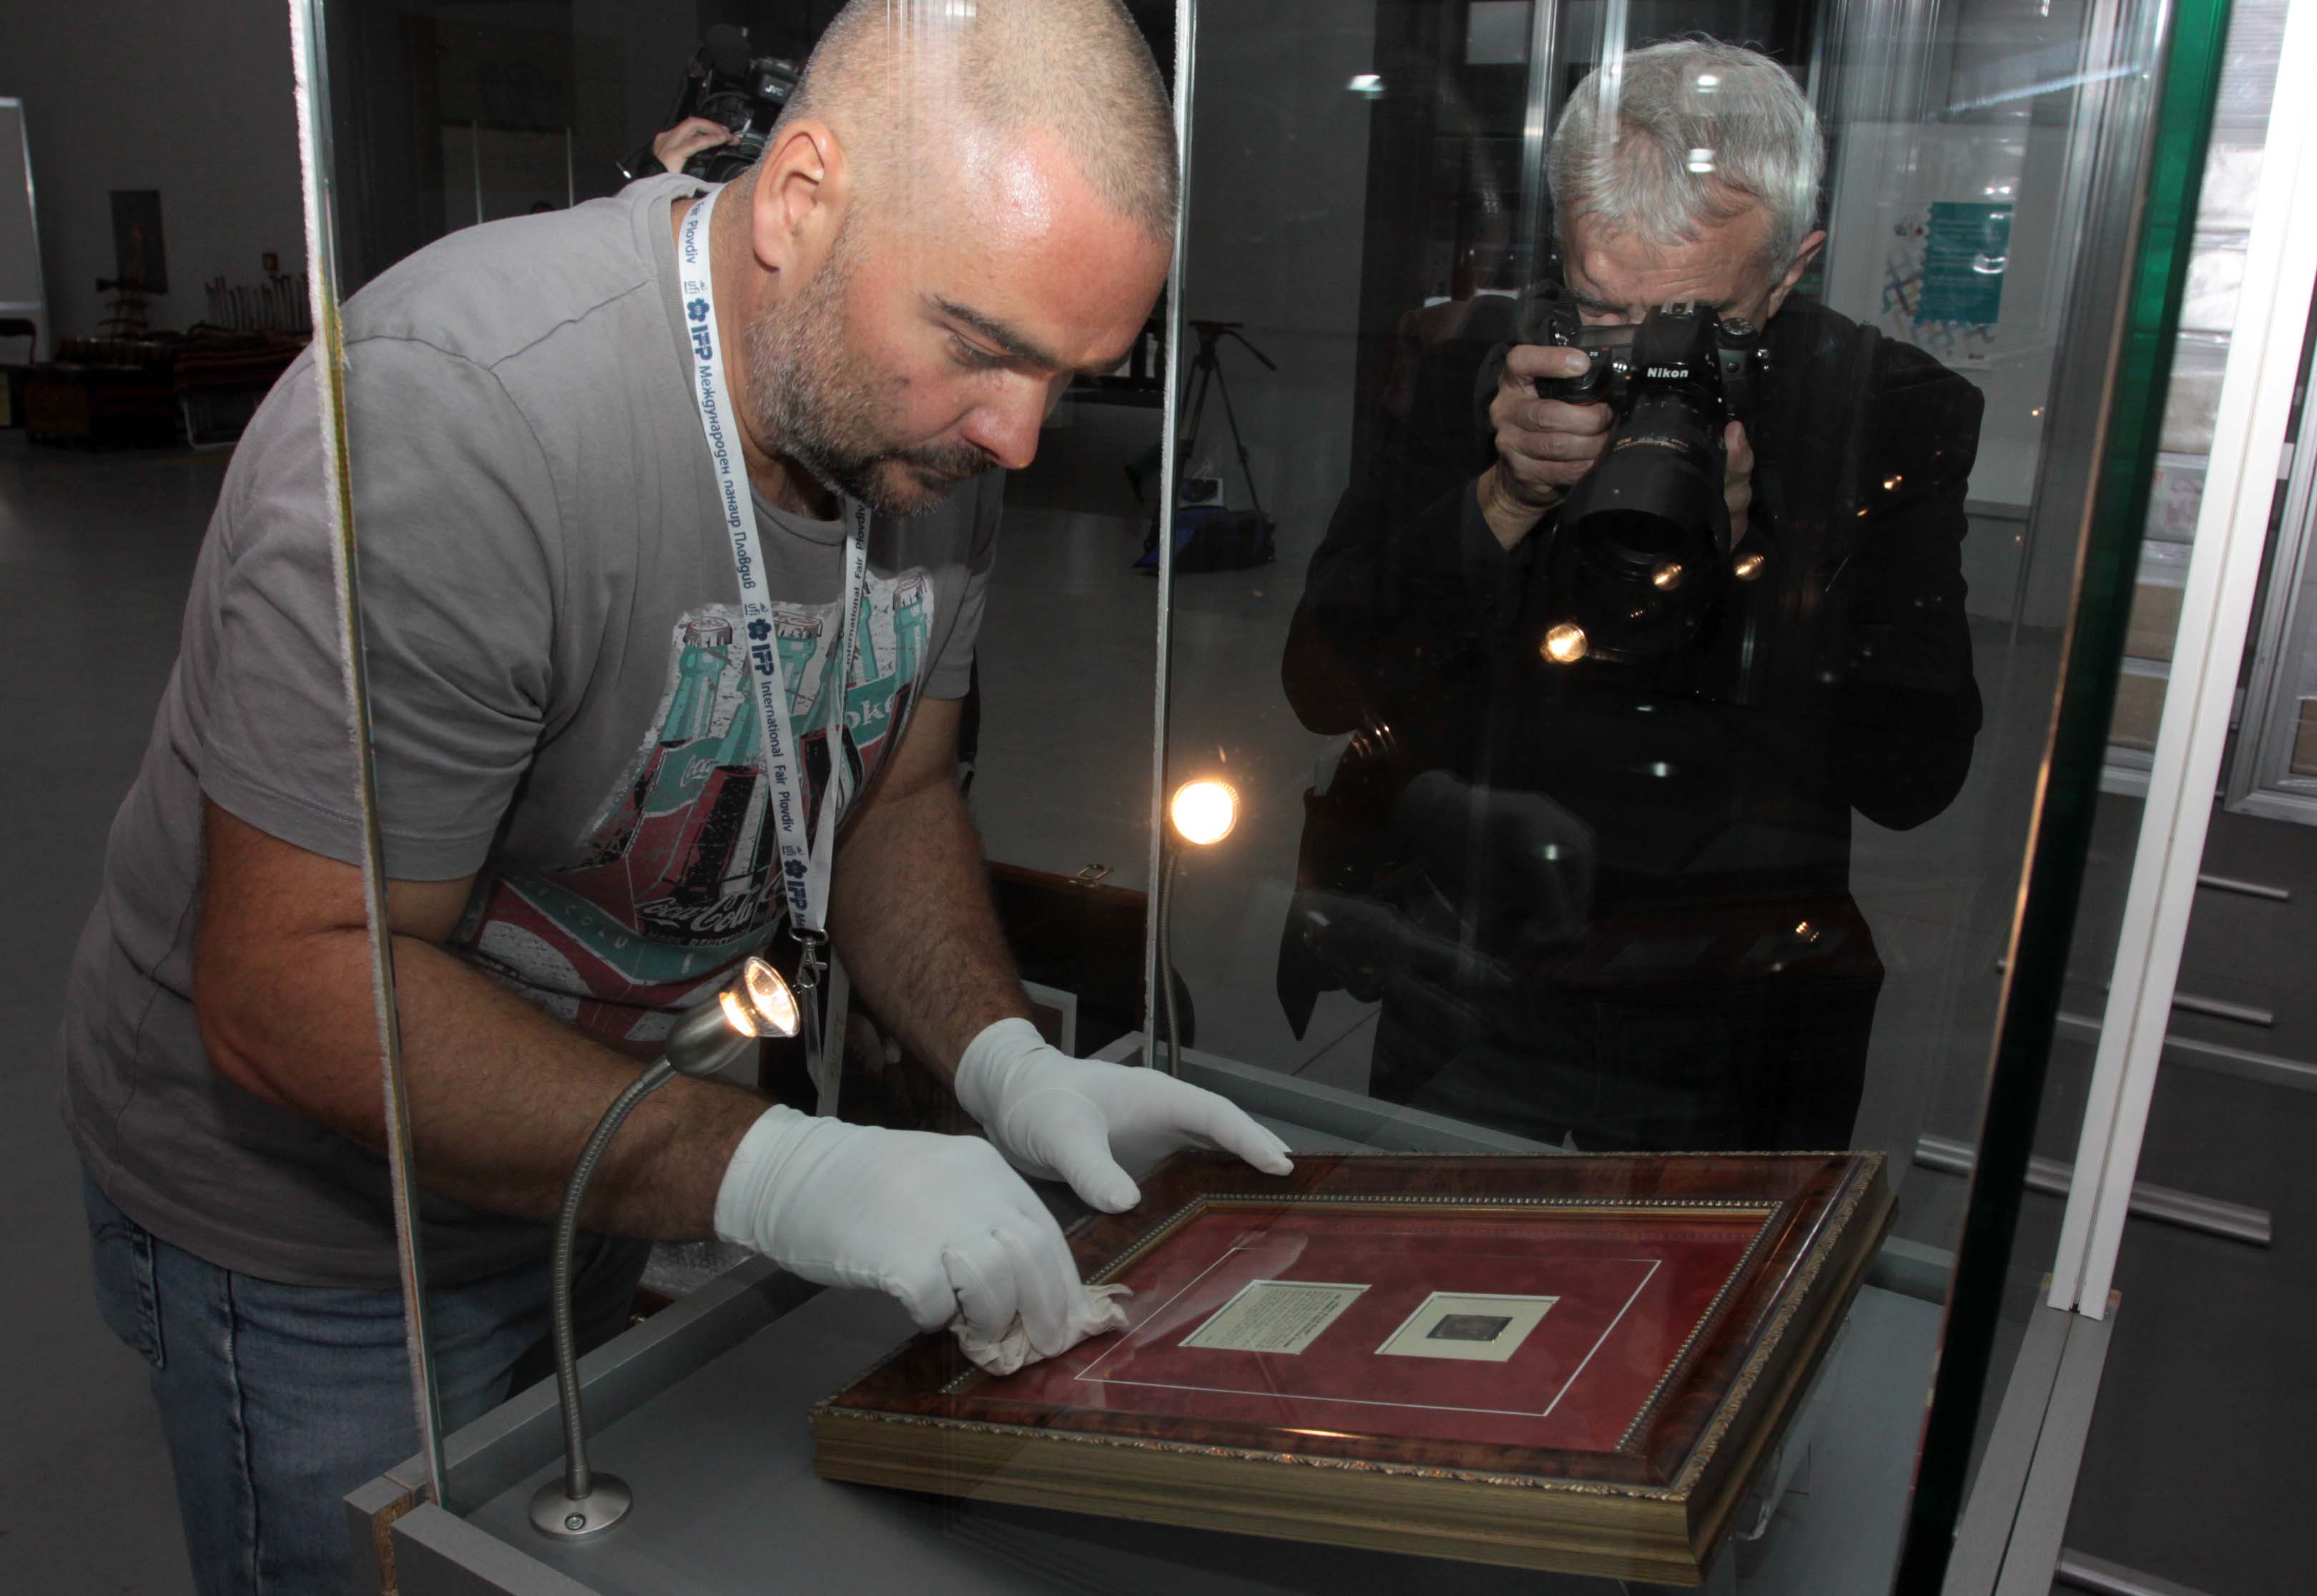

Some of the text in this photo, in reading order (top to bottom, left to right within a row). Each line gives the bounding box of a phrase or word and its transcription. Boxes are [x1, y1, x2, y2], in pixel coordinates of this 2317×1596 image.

[764, 84, 784, 97] JVC
[685, 220, 699, 265] Plovdiv
[692, 325, 714, 361] IFP
[1646, 367, 1689, 378] Nikon
[699, 365, 757, 590] Международен панаир Пловдив
[855, 504, 866, 550] Plovdiv
[854, 557, 864, 578] Fair
[751, 644, 774, 676] IFP
[847, 694, 894, 729] oke
[761, 681, 794, 832] International Fair Plovdiv
[787, 880, 808, 910] IFP
